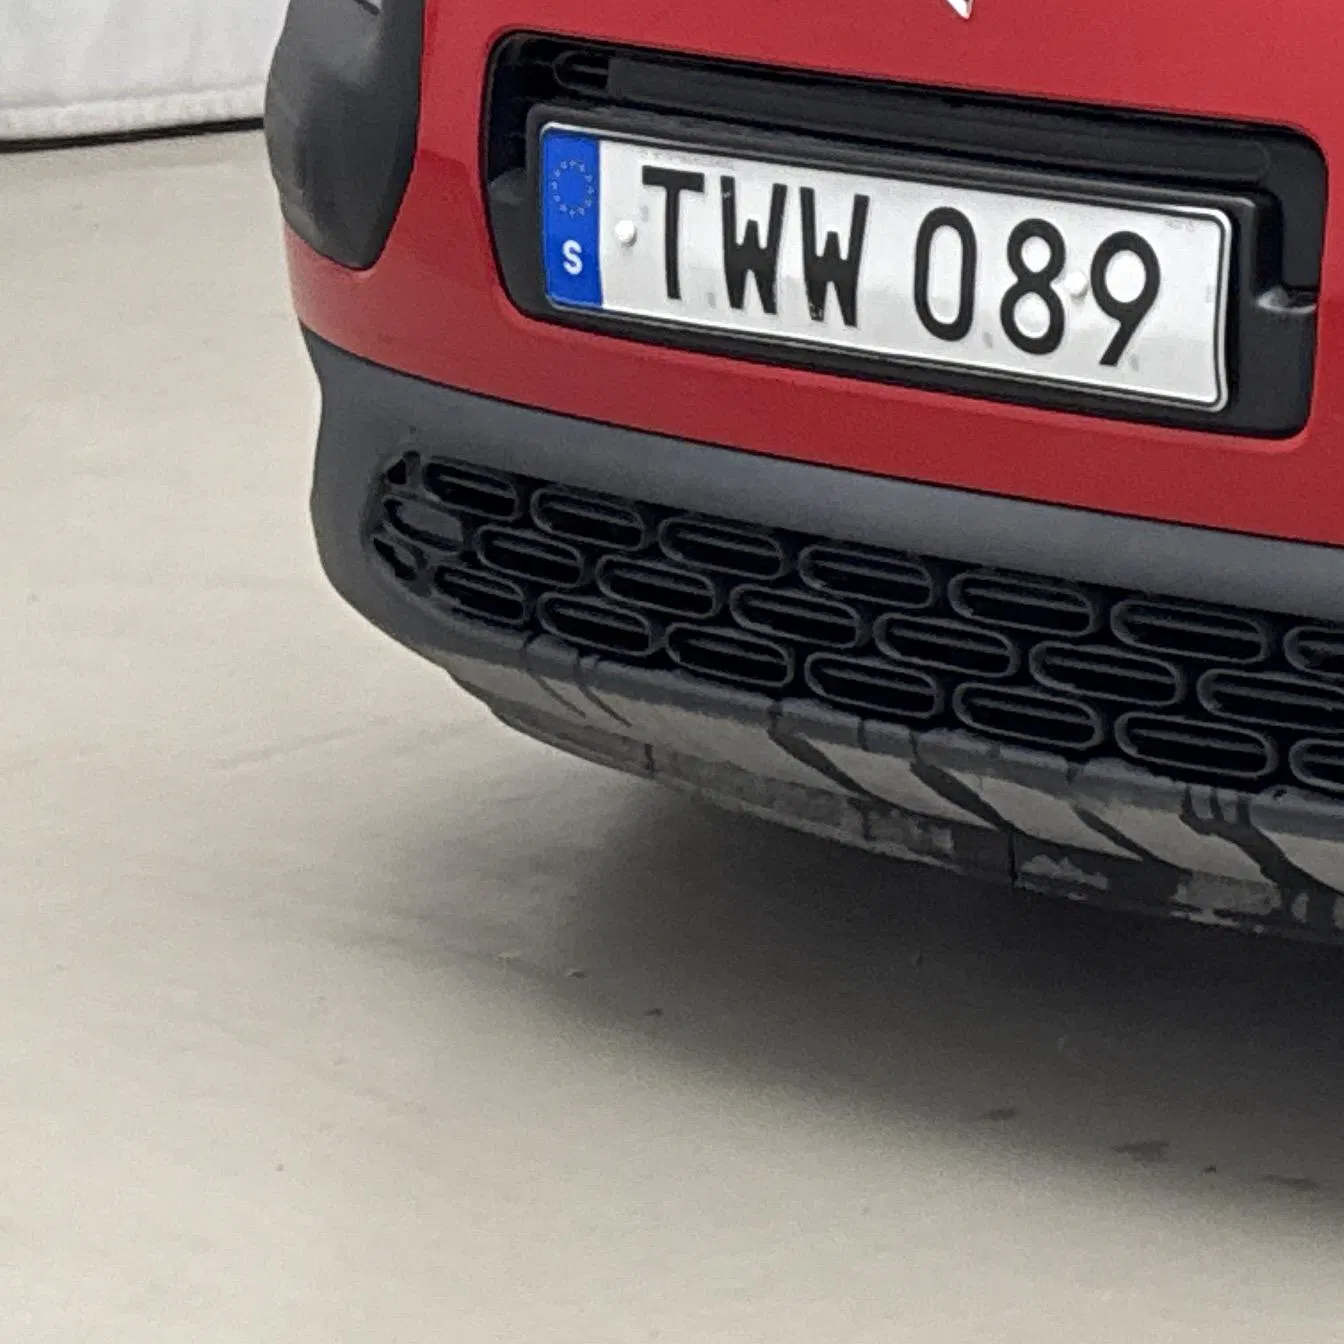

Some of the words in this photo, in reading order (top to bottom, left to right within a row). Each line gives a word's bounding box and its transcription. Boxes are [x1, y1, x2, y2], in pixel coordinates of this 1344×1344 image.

[562, 239, 584, 276] S
[642, 164, 870, 328] TWW
[913, 205, 1162, 368] 089
